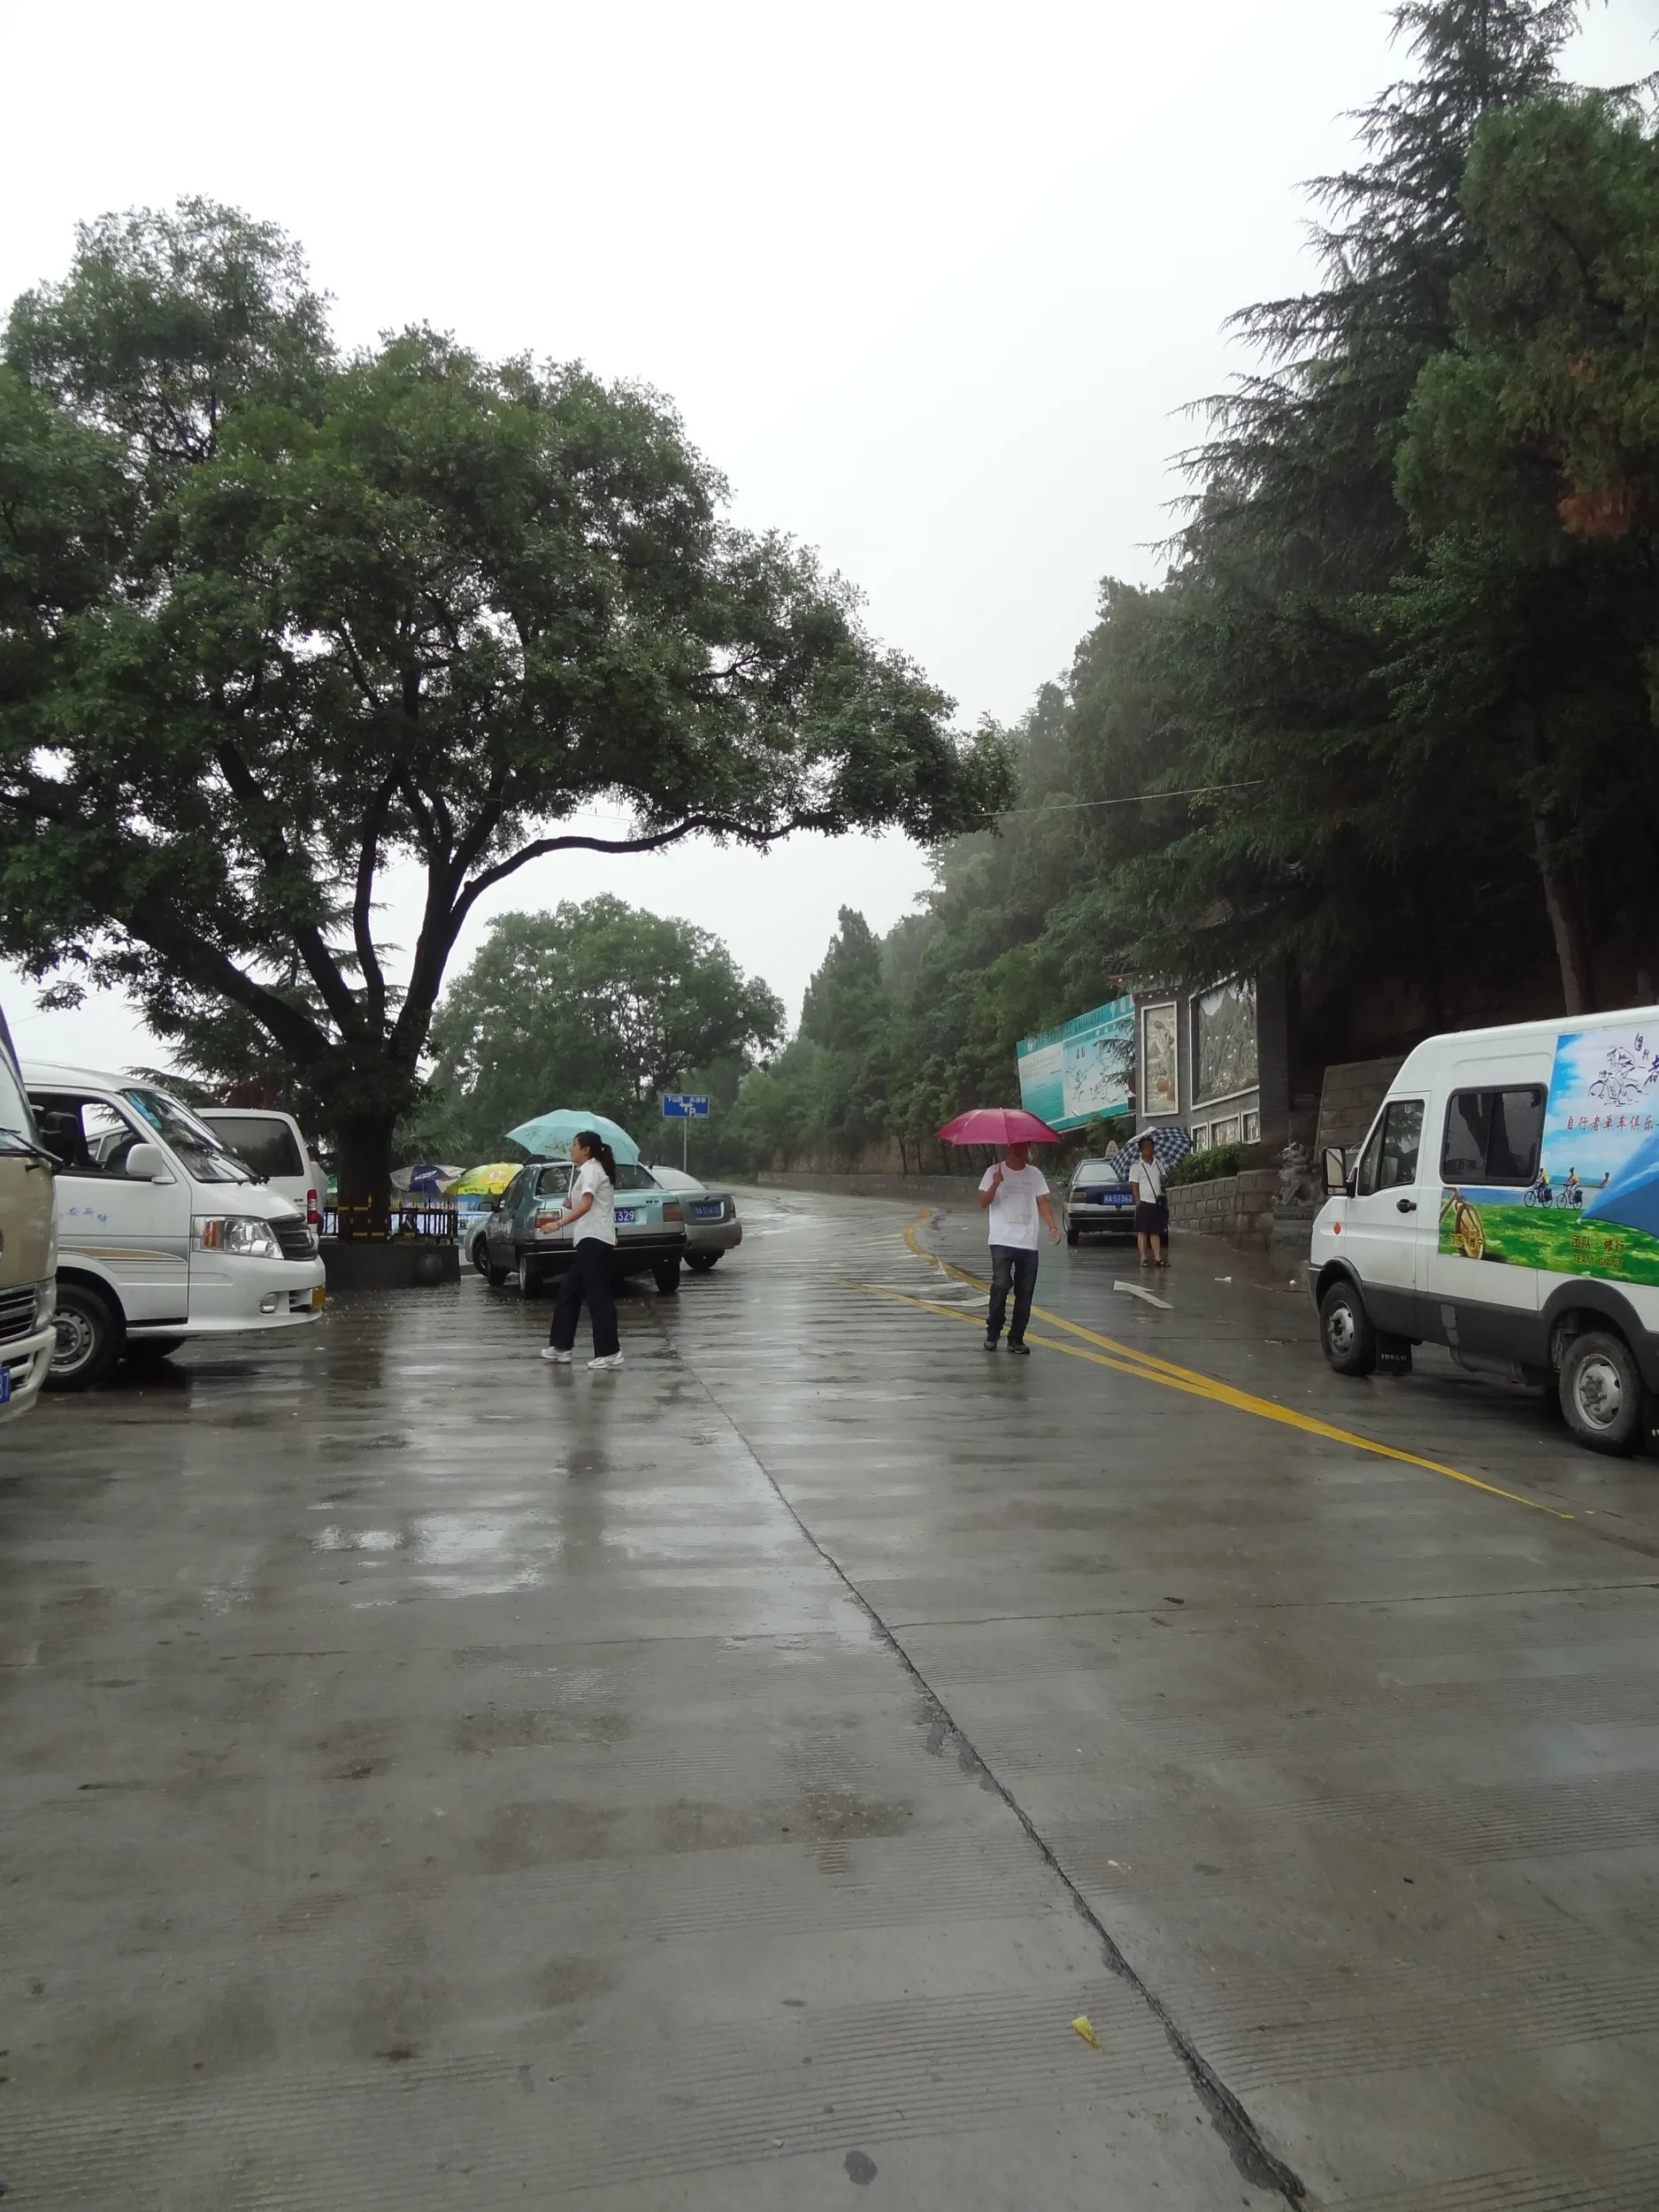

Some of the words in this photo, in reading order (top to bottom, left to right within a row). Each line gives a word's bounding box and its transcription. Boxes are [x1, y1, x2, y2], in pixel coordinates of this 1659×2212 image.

[689, 1107, 696, 1117] P
[1566, 1115, 1659, 1132] 自行者单车俱乐
[1572, 1254, 1594, 1264] TEAM
[1599, 1257, 1624, 1269] GIANT
